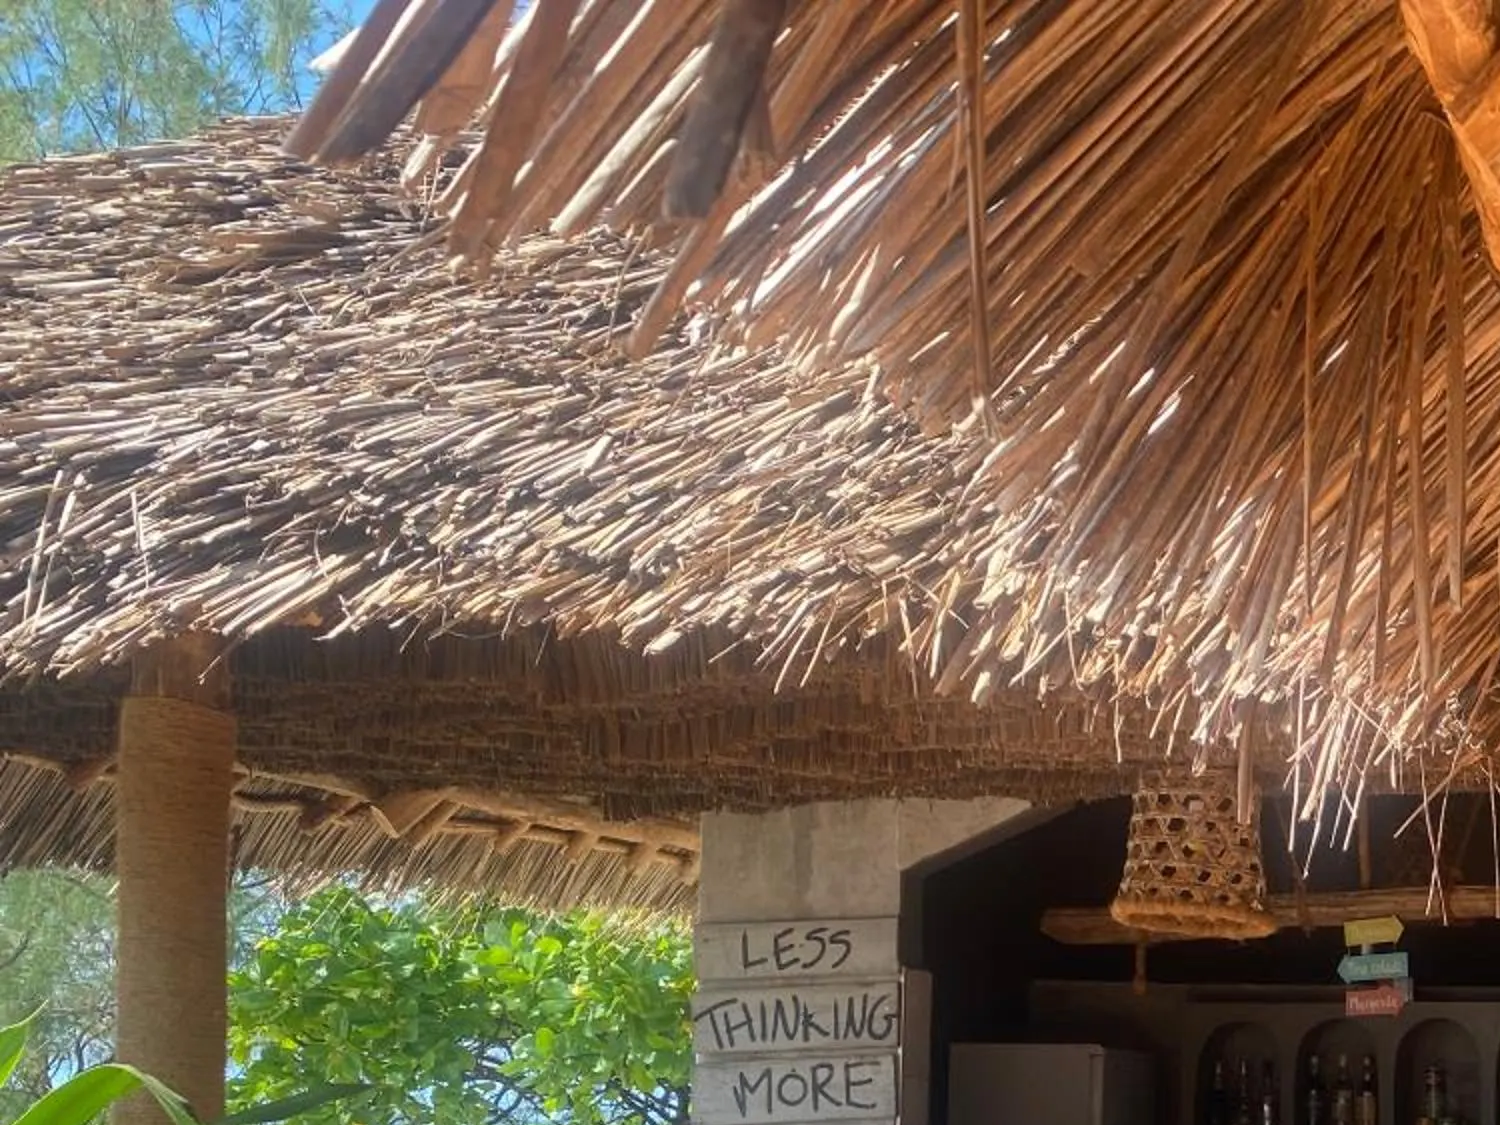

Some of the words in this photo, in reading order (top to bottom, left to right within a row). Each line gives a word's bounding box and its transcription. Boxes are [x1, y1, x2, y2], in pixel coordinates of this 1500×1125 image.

[741, 927, 851, 970] LESS
[694, 993, 898, 1050] THINKING
[733, 1062, 881, 1118] MORE
